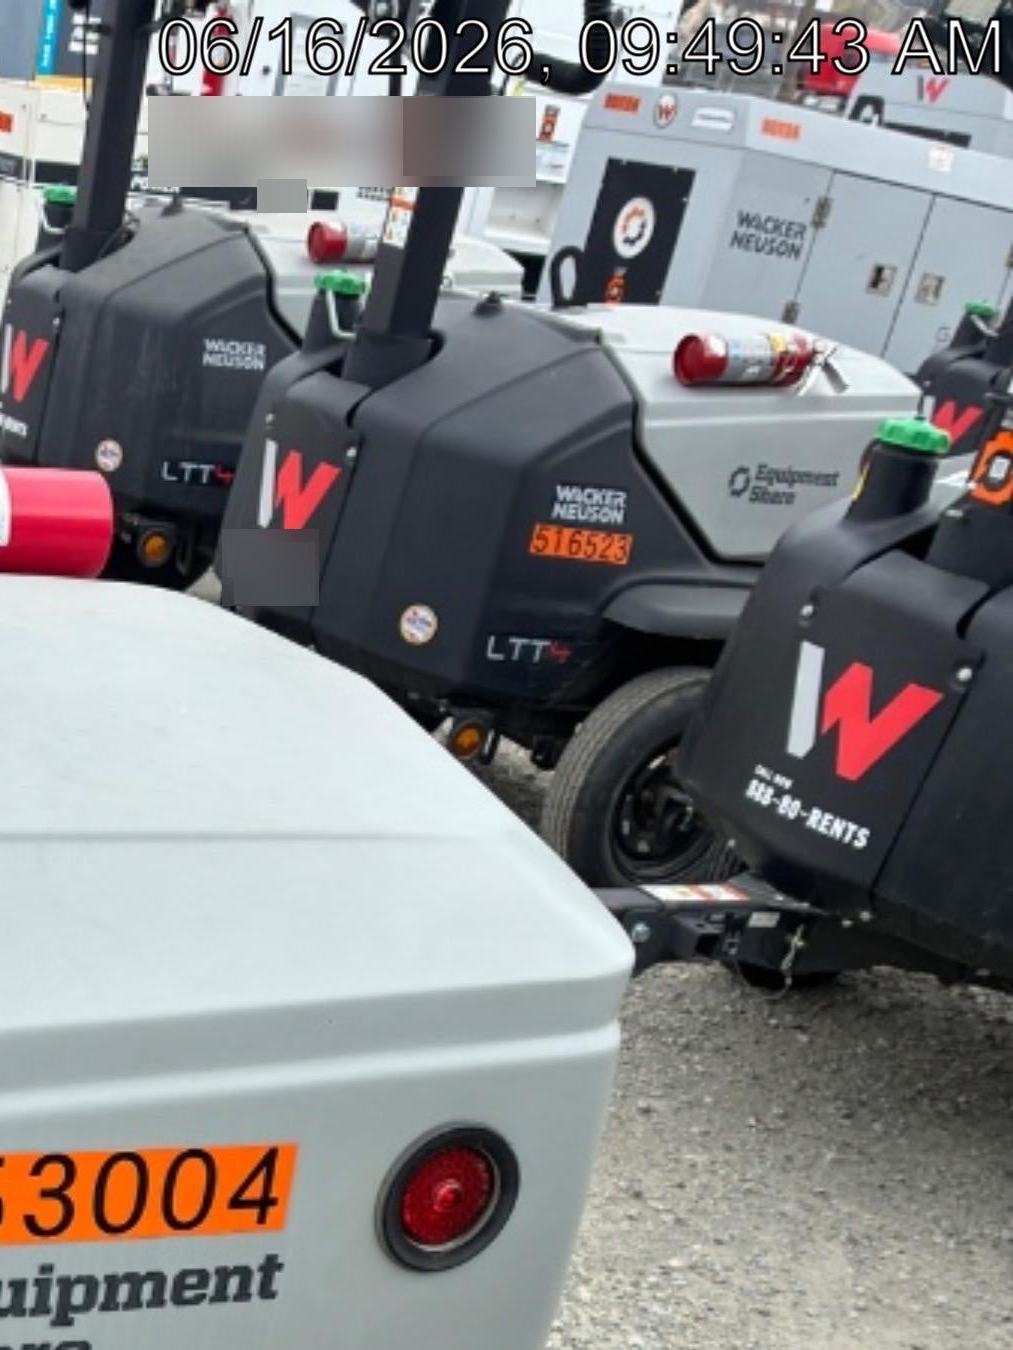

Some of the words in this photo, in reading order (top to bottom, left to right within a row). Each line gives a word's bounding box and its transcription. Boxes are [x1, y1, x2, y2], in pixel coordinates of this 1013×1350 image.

[737, 210, 807, 240] WACKER
[730, 231, 802, 260] NEUSON
[755, 463, 840, 488] Equipment
[556, 485, 627, 507] WACKER
[749, 485, 796, 505] Share
[551, 503, 624, 525] NEUSON
[533, 526, 630, 563] 516523
[487, 635, 573, 664] LTT4
